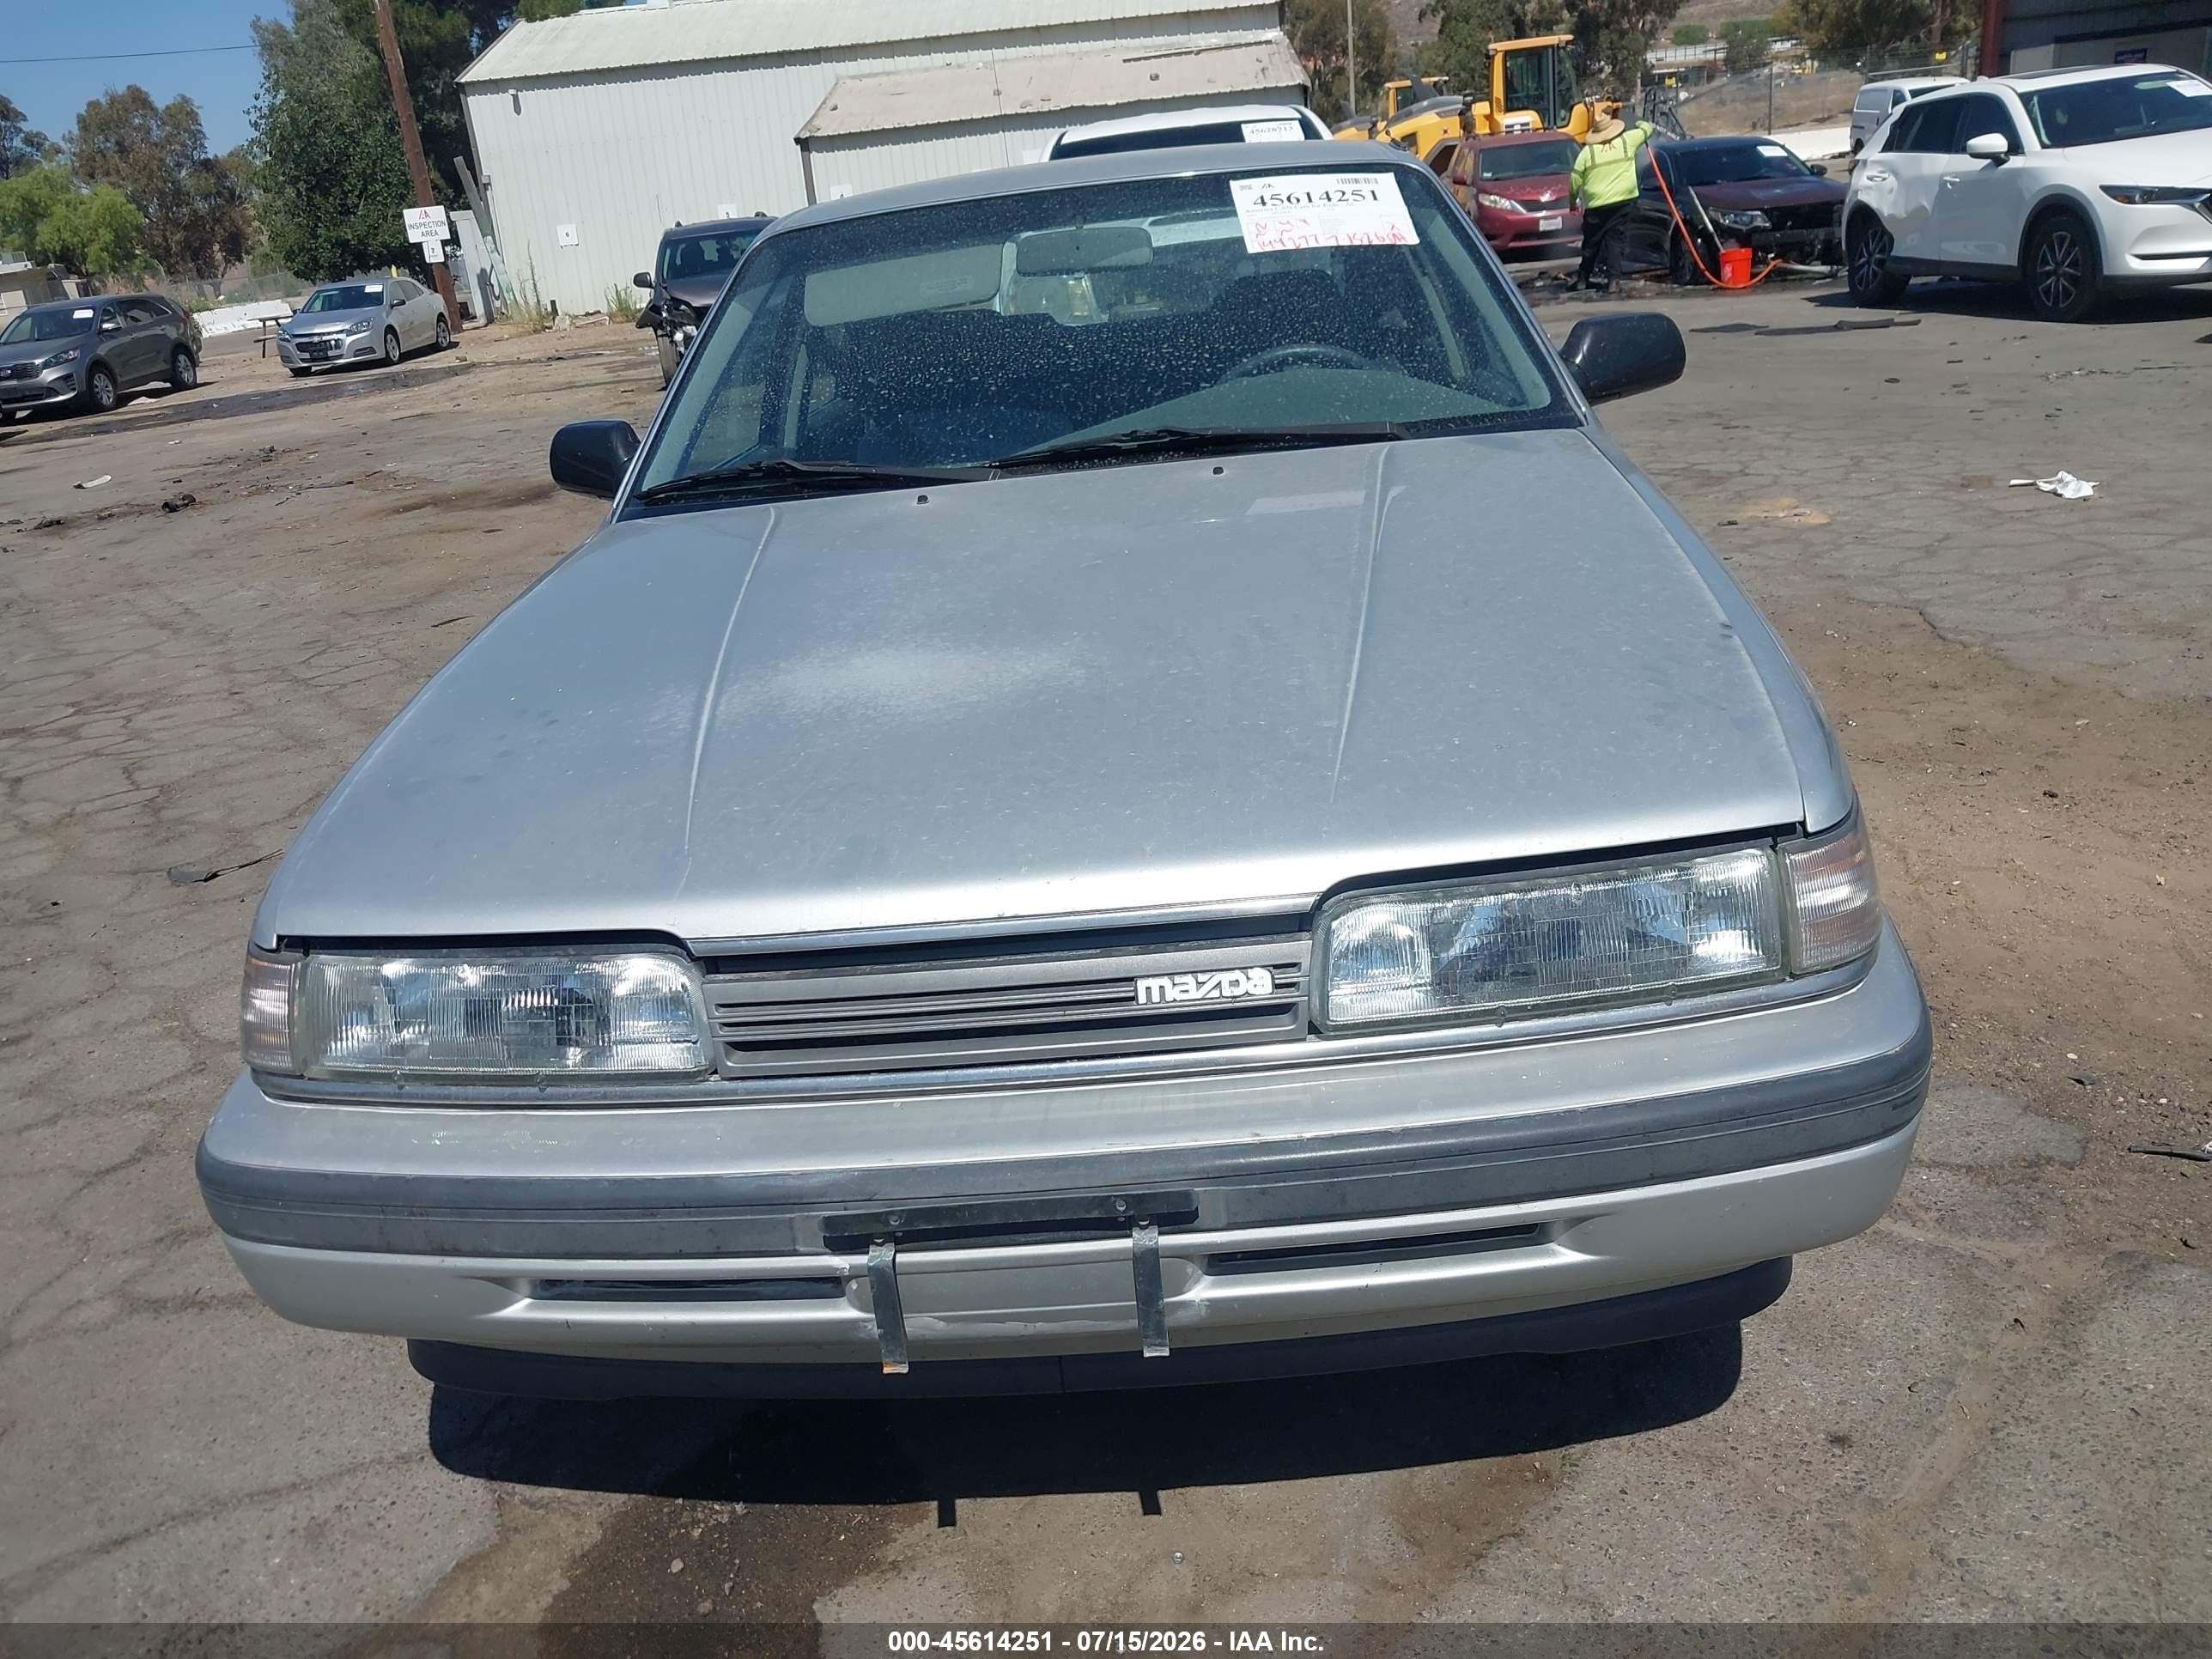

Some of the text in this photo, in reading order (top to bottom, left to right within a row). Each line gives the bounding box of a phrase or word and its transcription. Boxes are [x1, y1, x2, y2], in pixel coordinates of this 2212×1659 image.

[1253, 189, 1379, 207] 45614251
[408, 220, 446, 230] INSPECTION
[421, 229, 439, 238] AREA
